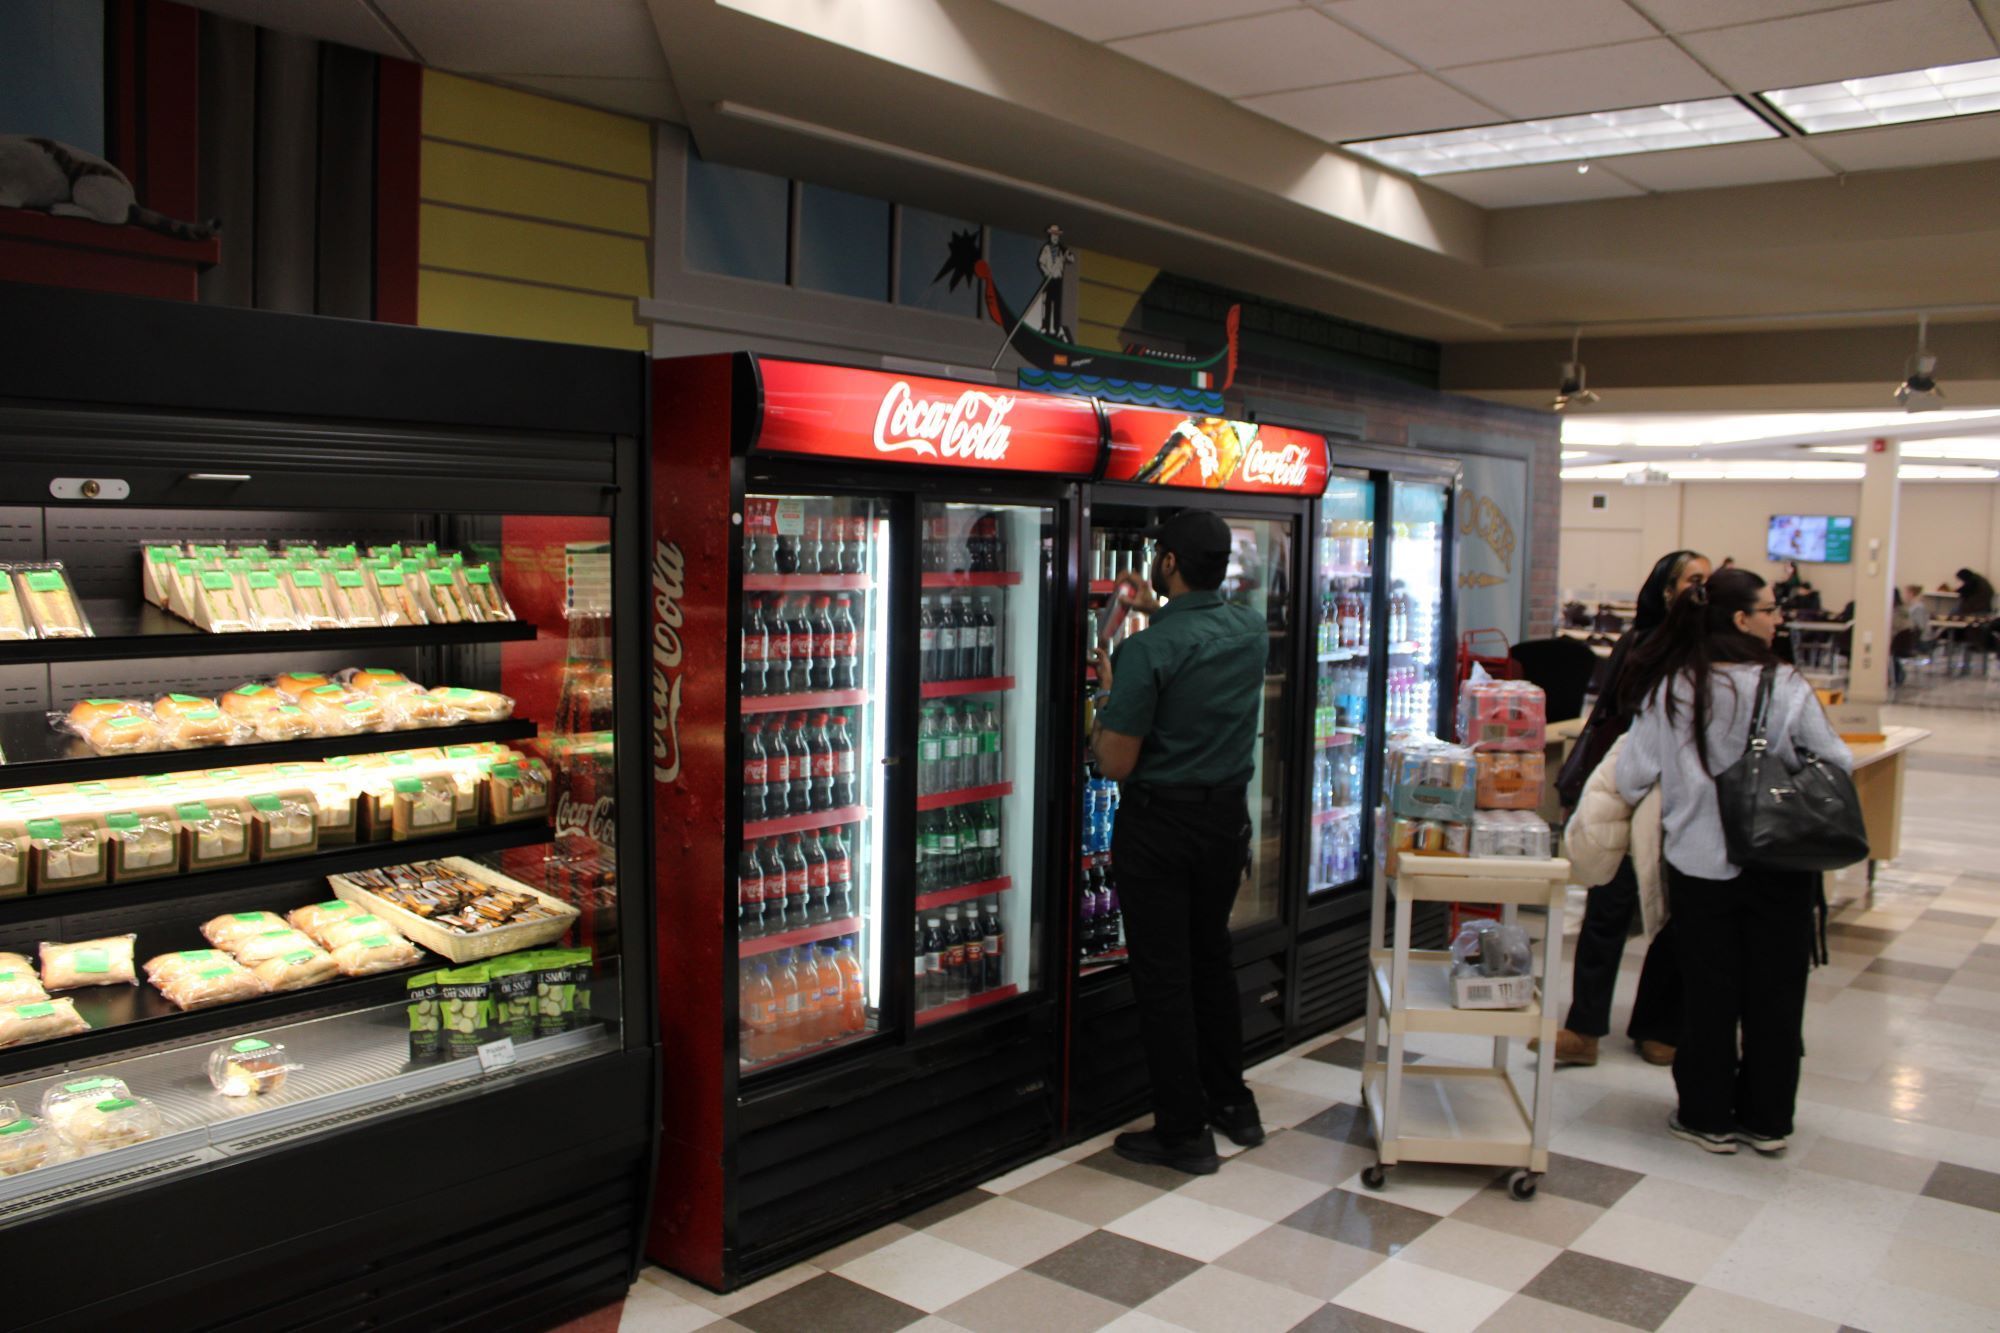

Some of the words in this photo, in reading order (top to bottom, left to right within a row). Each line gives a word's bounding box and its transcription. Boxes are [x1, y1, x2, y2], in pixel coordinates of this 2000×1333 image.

[873, 380, 1016, 461] Coca-Cola
[1243, 440, 1310, 486] Coca-Cola
[652, 540, 684, 783] CocaCola
[458, 986, 487, 998] SNAP!
